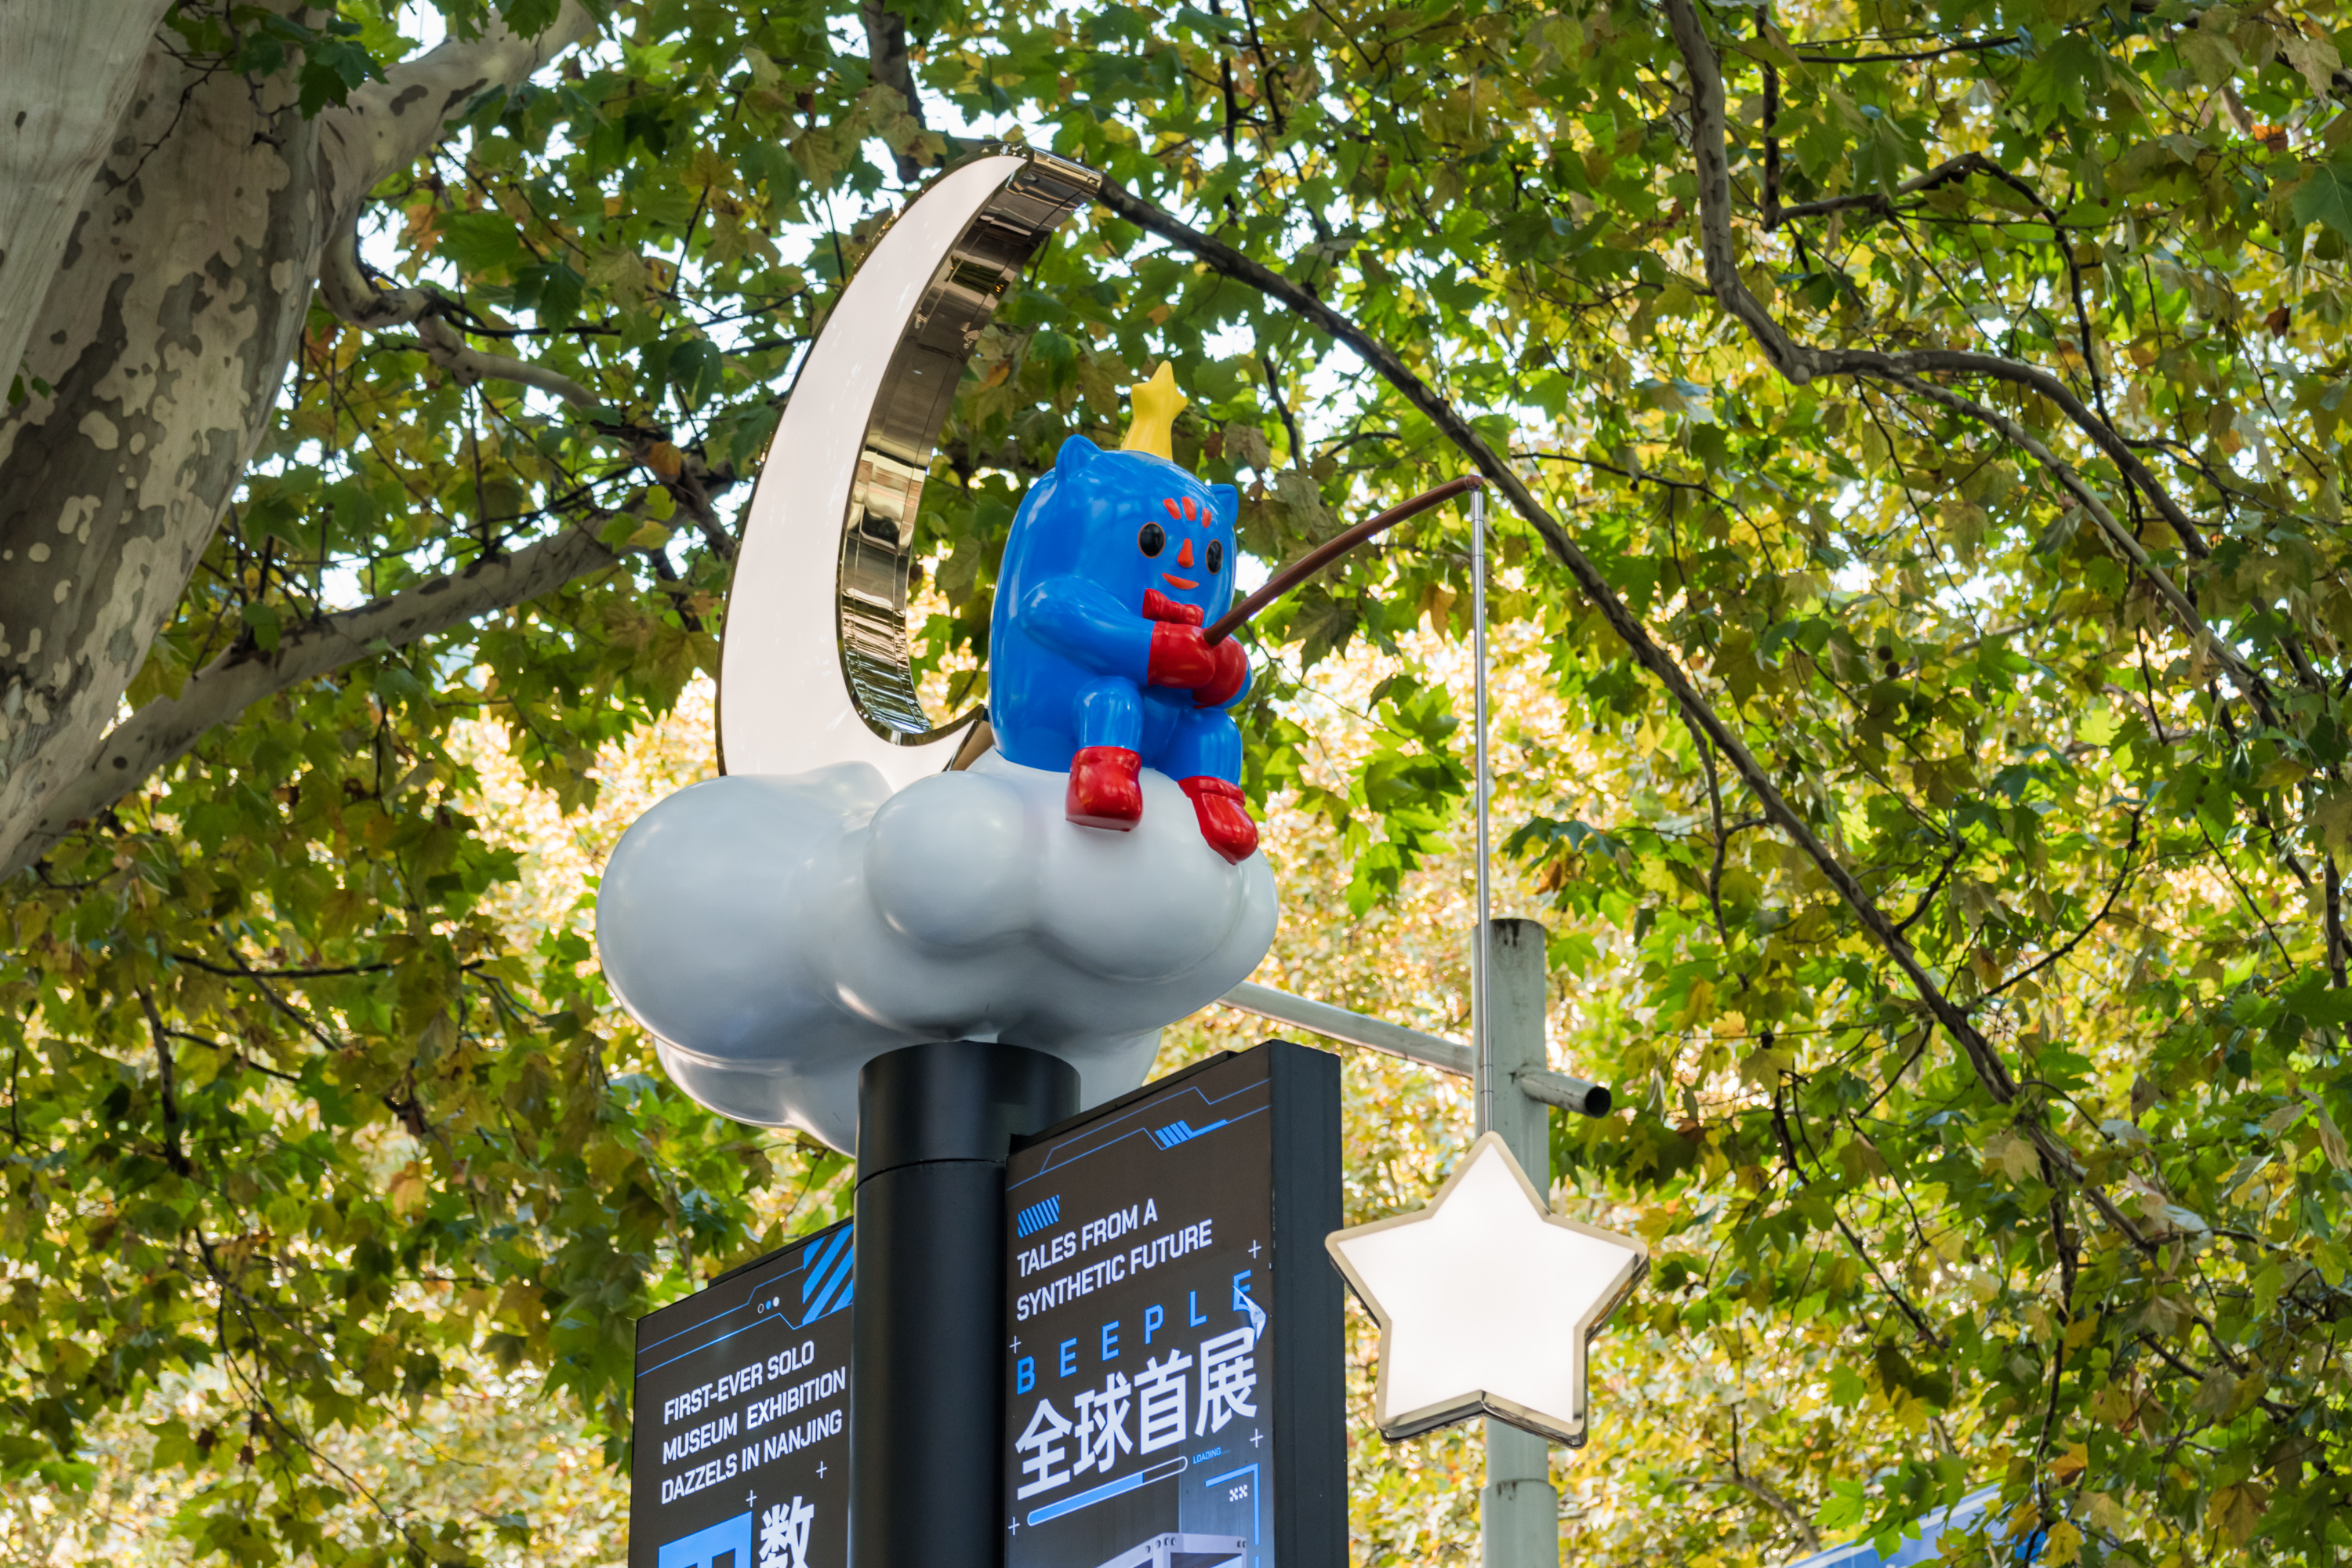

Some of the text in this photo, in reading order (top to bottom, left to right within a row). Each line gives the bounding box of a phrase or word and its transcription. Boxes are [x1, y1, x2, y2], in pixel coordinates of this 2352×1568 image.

[1016, 1218, 1213, 1322] SYNTHETIC FUTURE
[1017, 1198, 1159, 1278] TALES FROM A
[1016, 1269, 1252, 1396] BEEPLE
[662, 1366, 846, 1465] MUSEUM EXHIBITION
[663, 1340, 815, 1425] FIRST-EVER SOLO
[1014, 1325, 1258, 1501] 全球首展
[661, 1408, 843, 1505] DAZZELS IN NANJING
